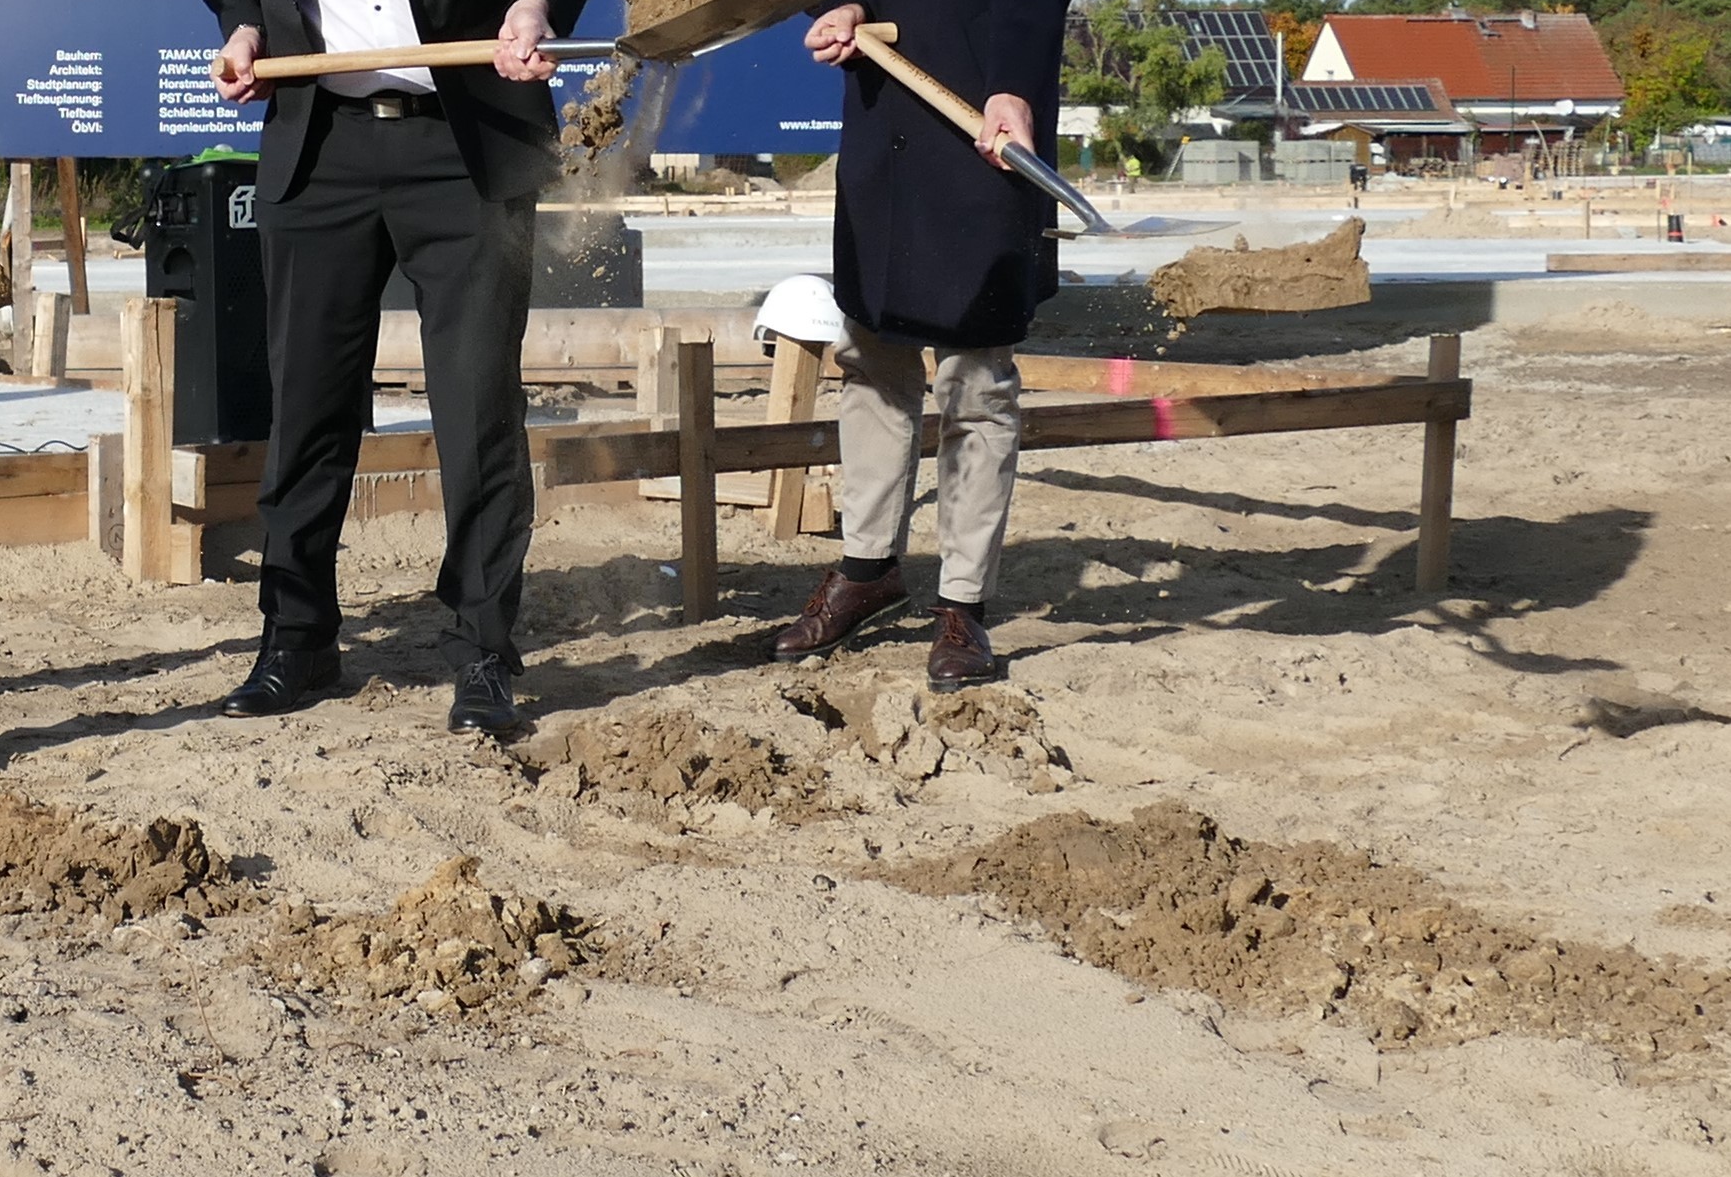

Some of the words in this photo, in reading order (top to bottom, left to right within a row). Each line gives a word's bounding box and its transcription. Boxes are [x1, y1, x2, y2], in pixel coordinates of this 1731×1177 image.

[158, 49, 202, 61] TAMAX
[49, 64, 102, 75] Architekt:
[26, 78, 102, 92] Stadtplanung:
[15, 93, 102, 106] Tiefbauplanung:
[159, 93, 181, 104] PST
[183, 92, 219, 104] GmbH
[58, 107, 102, 118] Tiefbau:
[159, 107, 215, 118] Schielicke
[216, 107, 238, 118] Bau
[159, 121, 234, 135] Ingenieurbüro
